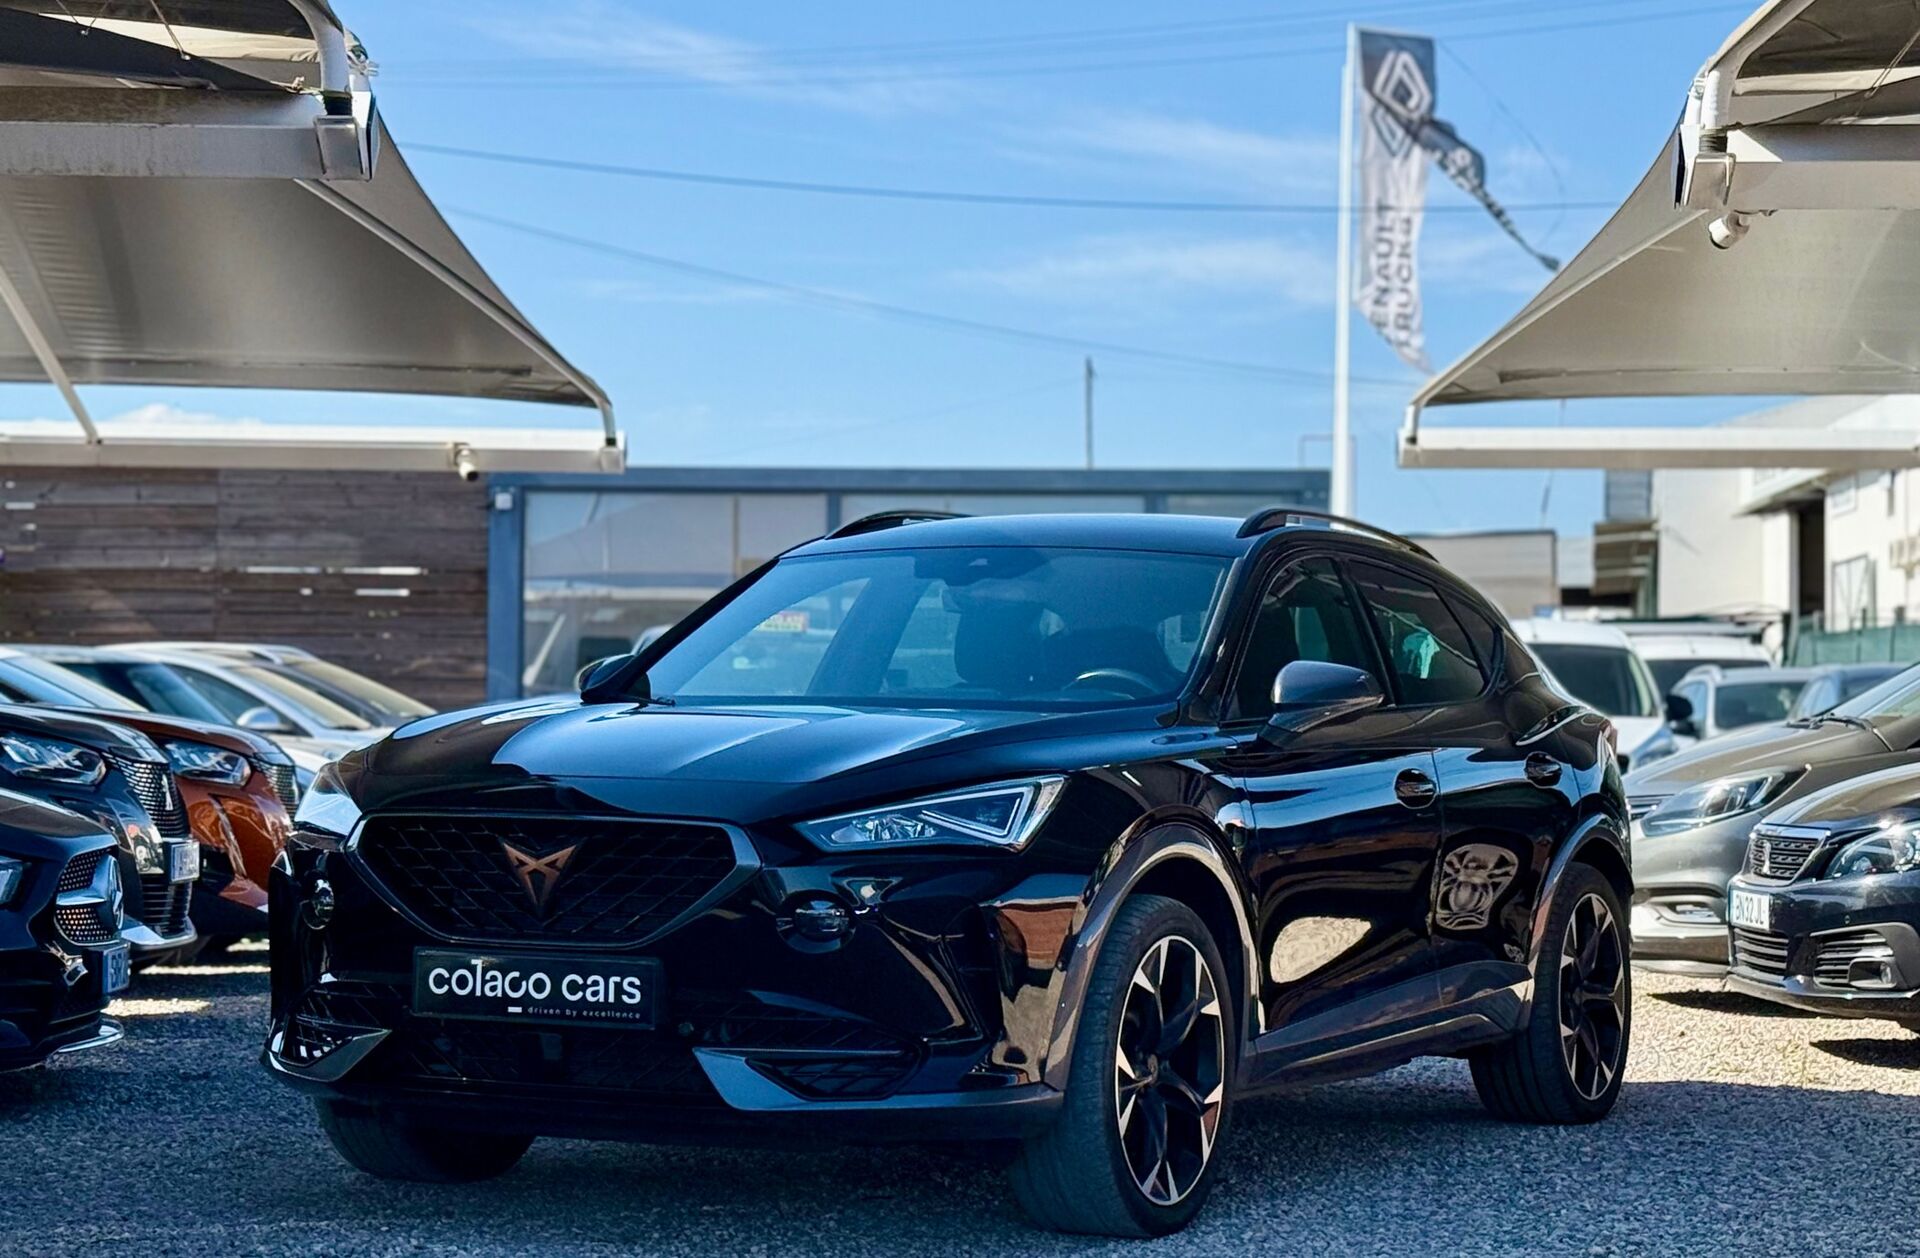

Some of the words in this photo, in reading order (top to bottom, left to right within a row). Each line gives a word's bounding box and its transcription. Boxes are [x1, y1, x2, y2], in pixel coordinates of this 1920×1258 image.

[561, 973, 642, 1005] cars
[527, 1006, 561, 1015] driven
[565, 1008, 577, 1017] by
[582, 1010, 641, 1019] excellence
